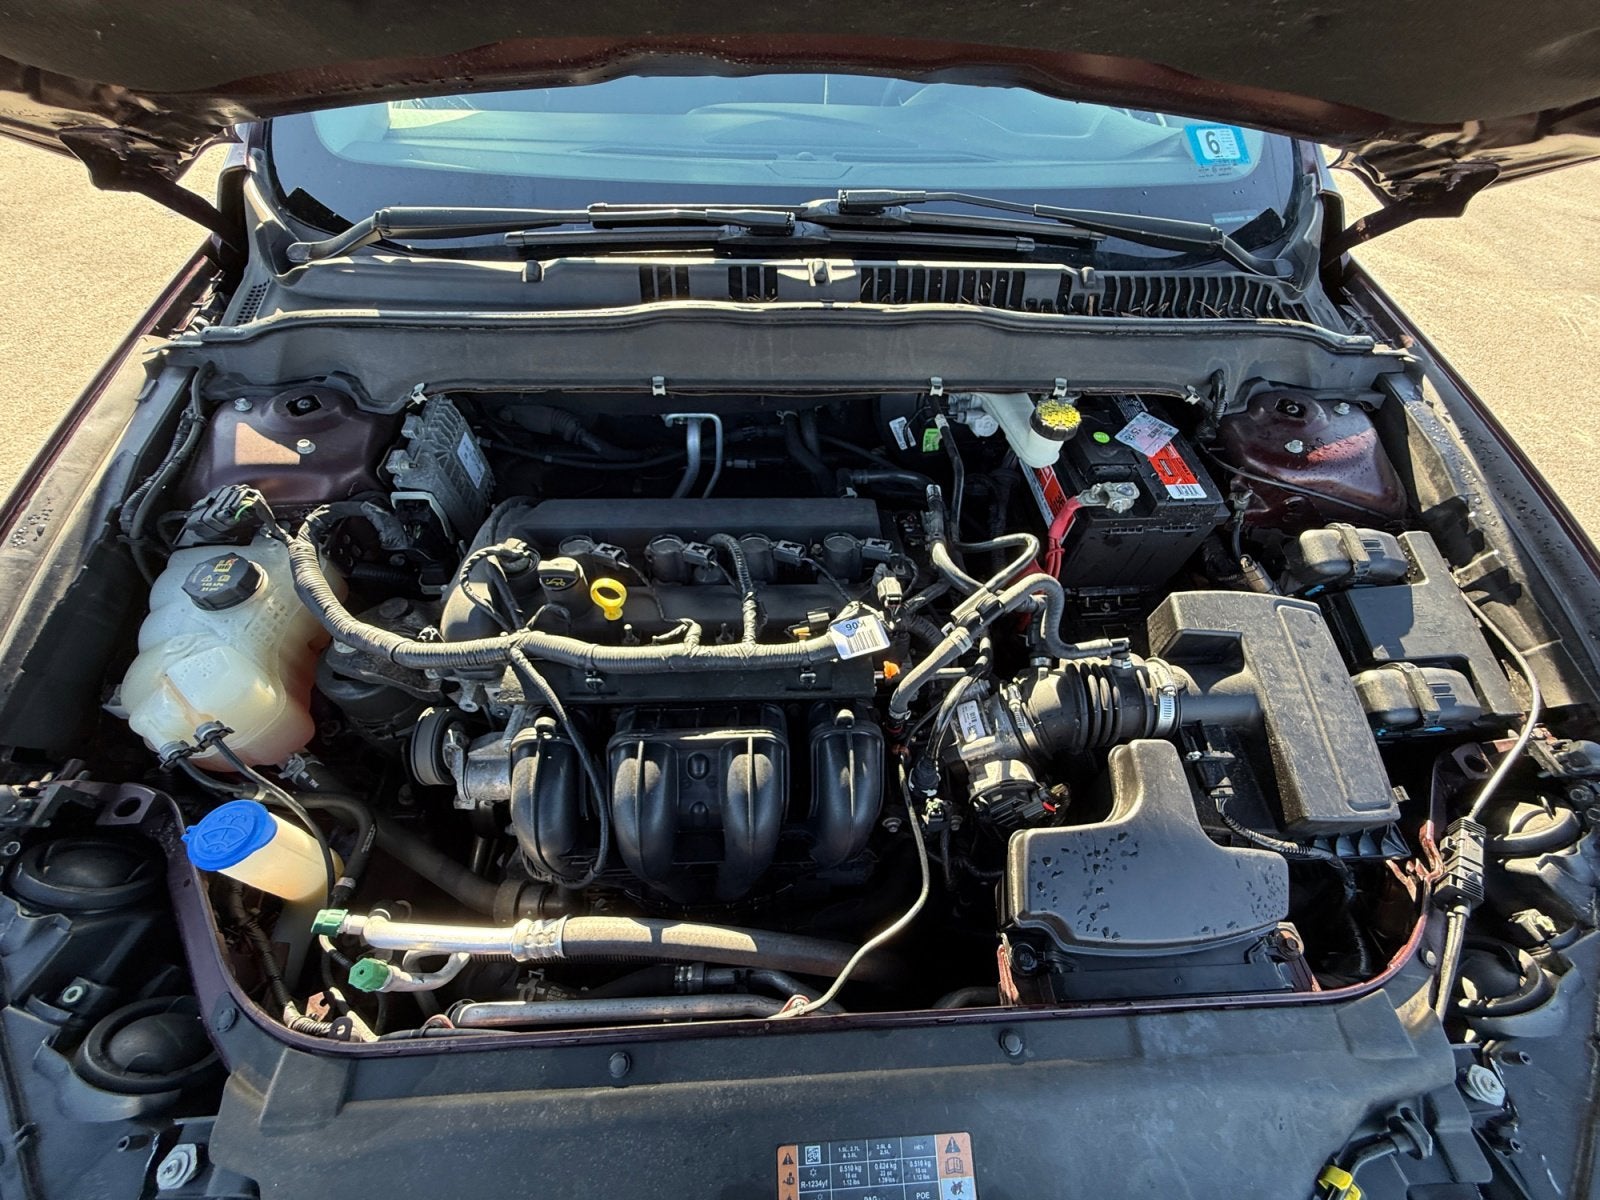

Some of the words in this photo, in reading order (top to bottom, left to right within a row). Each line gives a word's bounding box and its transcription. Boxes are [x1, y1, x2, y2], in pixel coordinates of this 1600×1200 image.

[1206, 130, 1220, 154] 6
[855, 1165, 862, 1173] kg
[800, 1180, 828, 1189] R-1234yf
